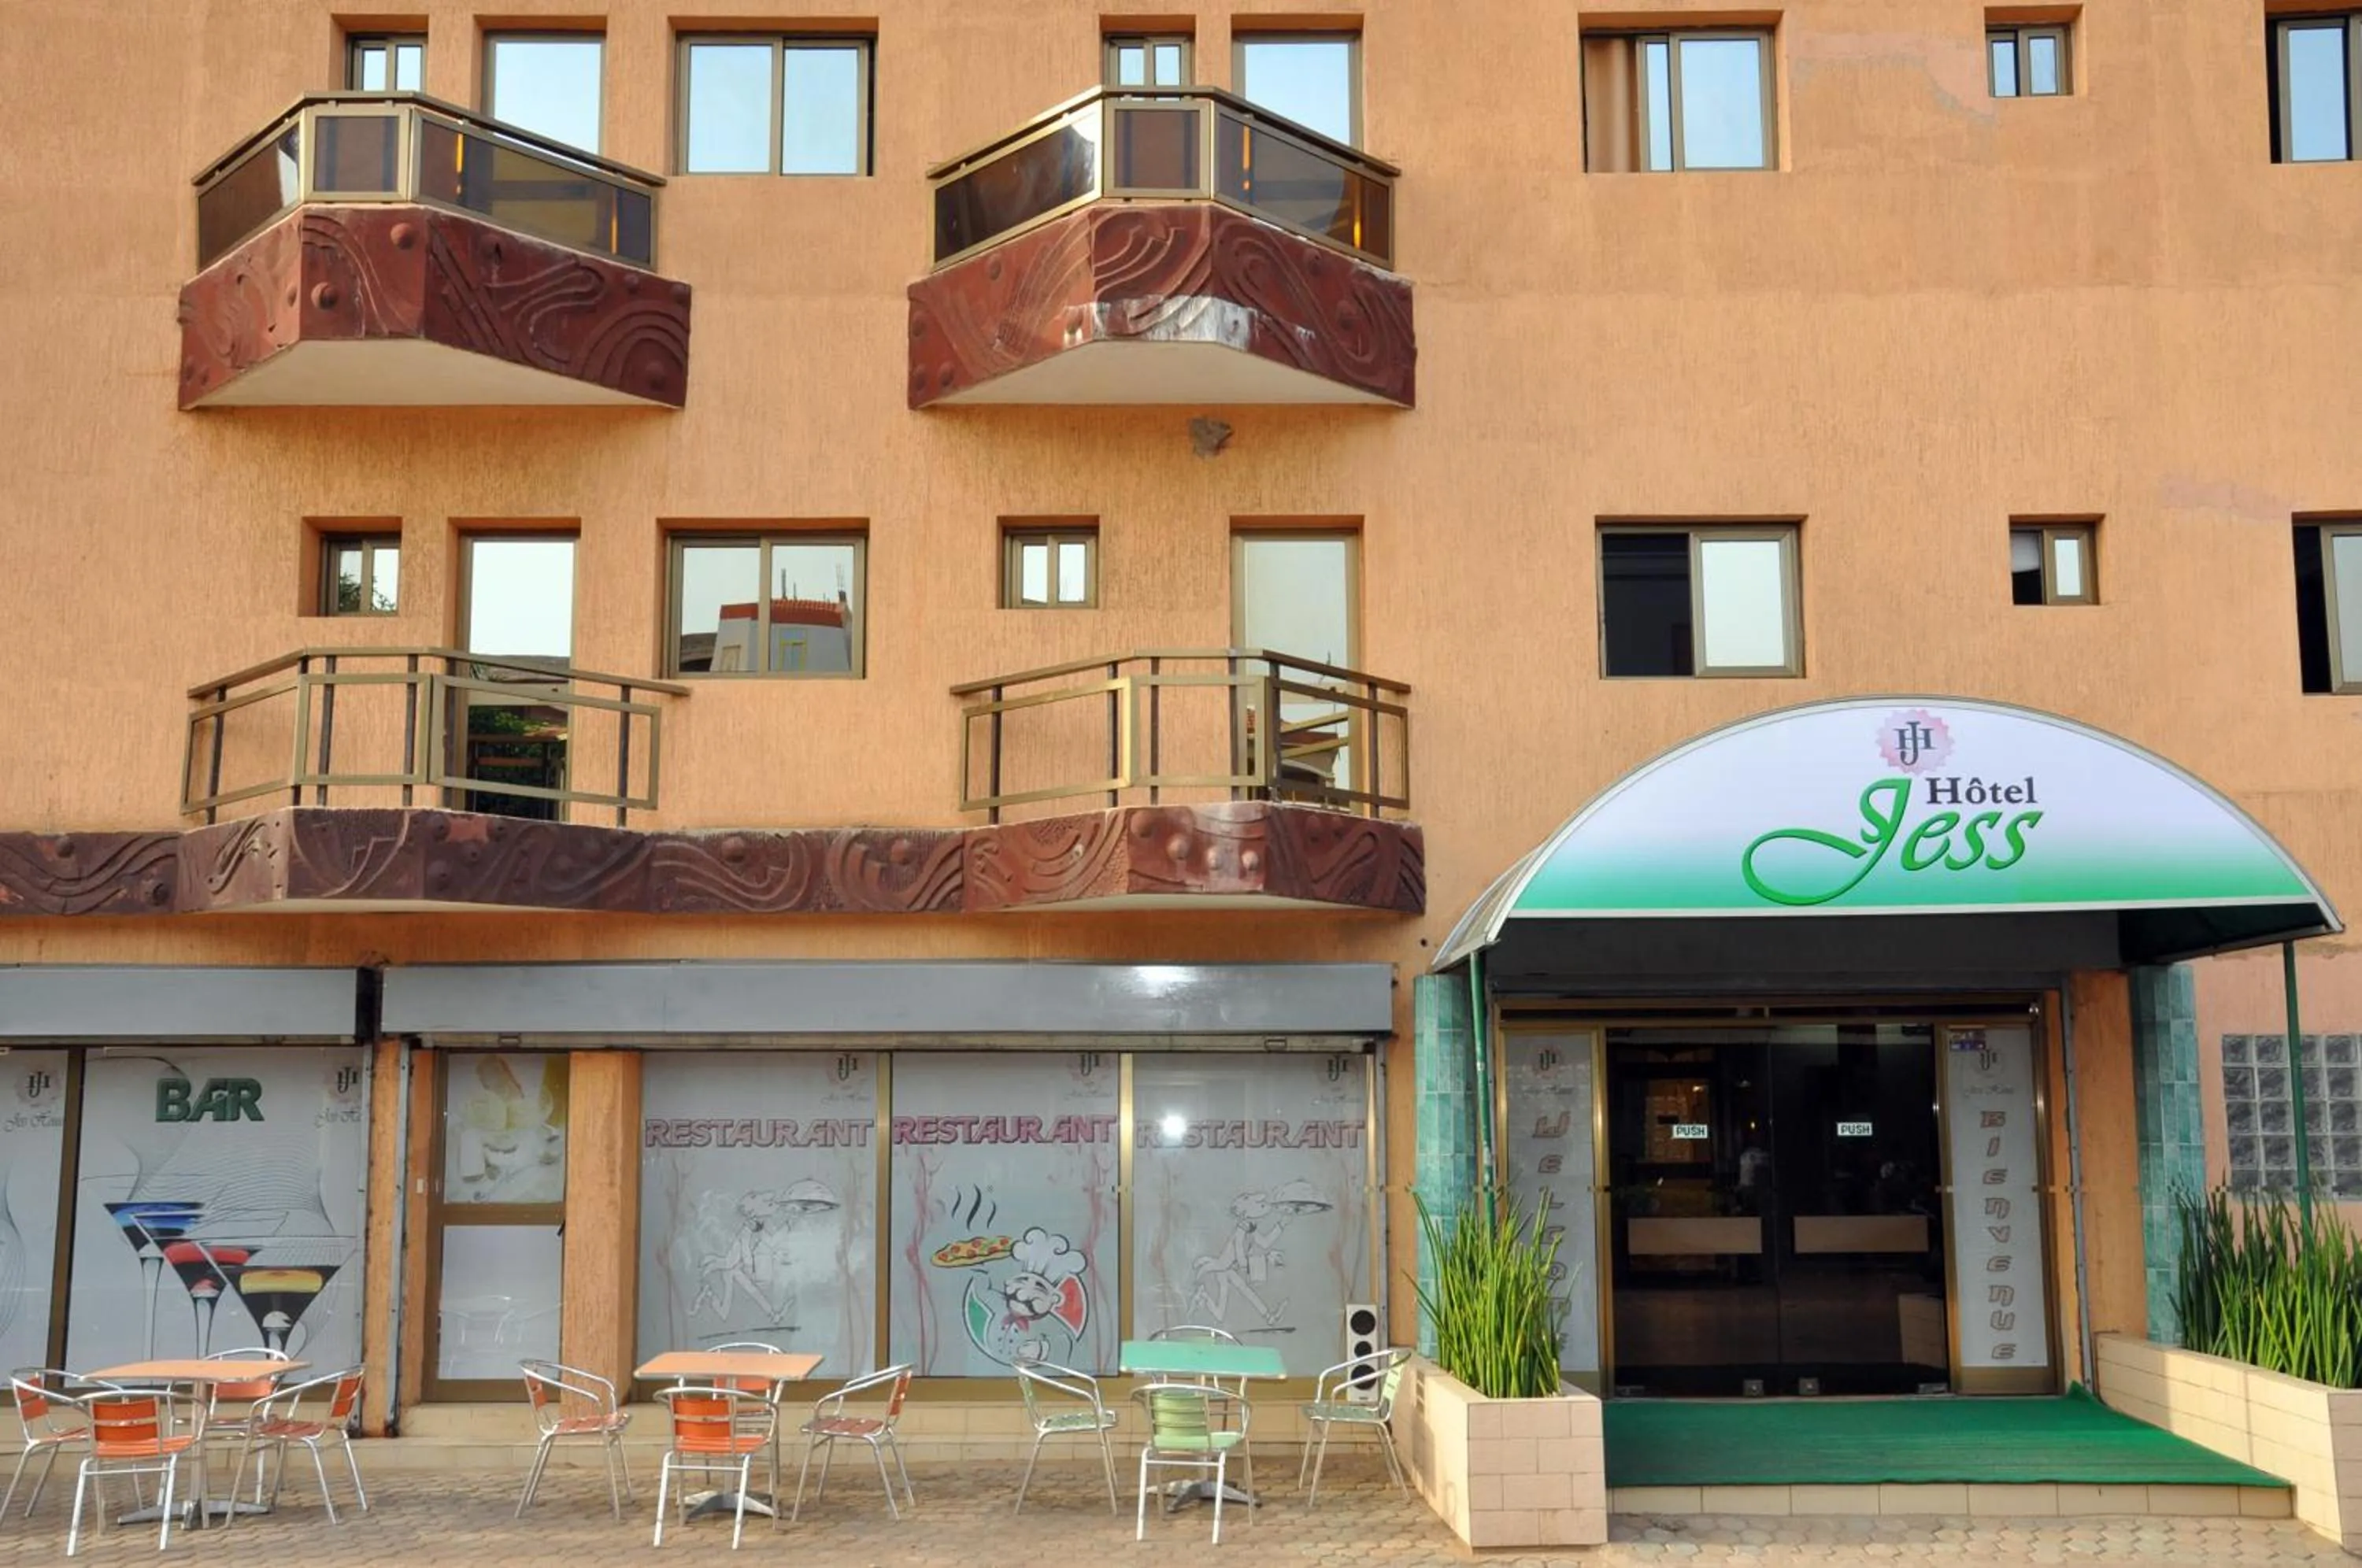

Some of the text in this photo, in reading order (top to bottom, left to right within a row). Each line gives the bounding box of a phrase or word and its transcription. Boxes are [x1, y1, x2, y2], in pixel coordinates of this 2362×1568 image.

[1925, 776, 2039, 805] Hôtel
[1741, 777, 2045, 907] Jess
[155, 1078, 265, 1123] BAR
[645, 1119, 875, 1148] RESTAURANT
[893, 1115, 1117, 1145] RESTAURANT
[1675, 1126, 1706, 1137] PUSH
[1840, 1124, 1870, 1135] PUSH
